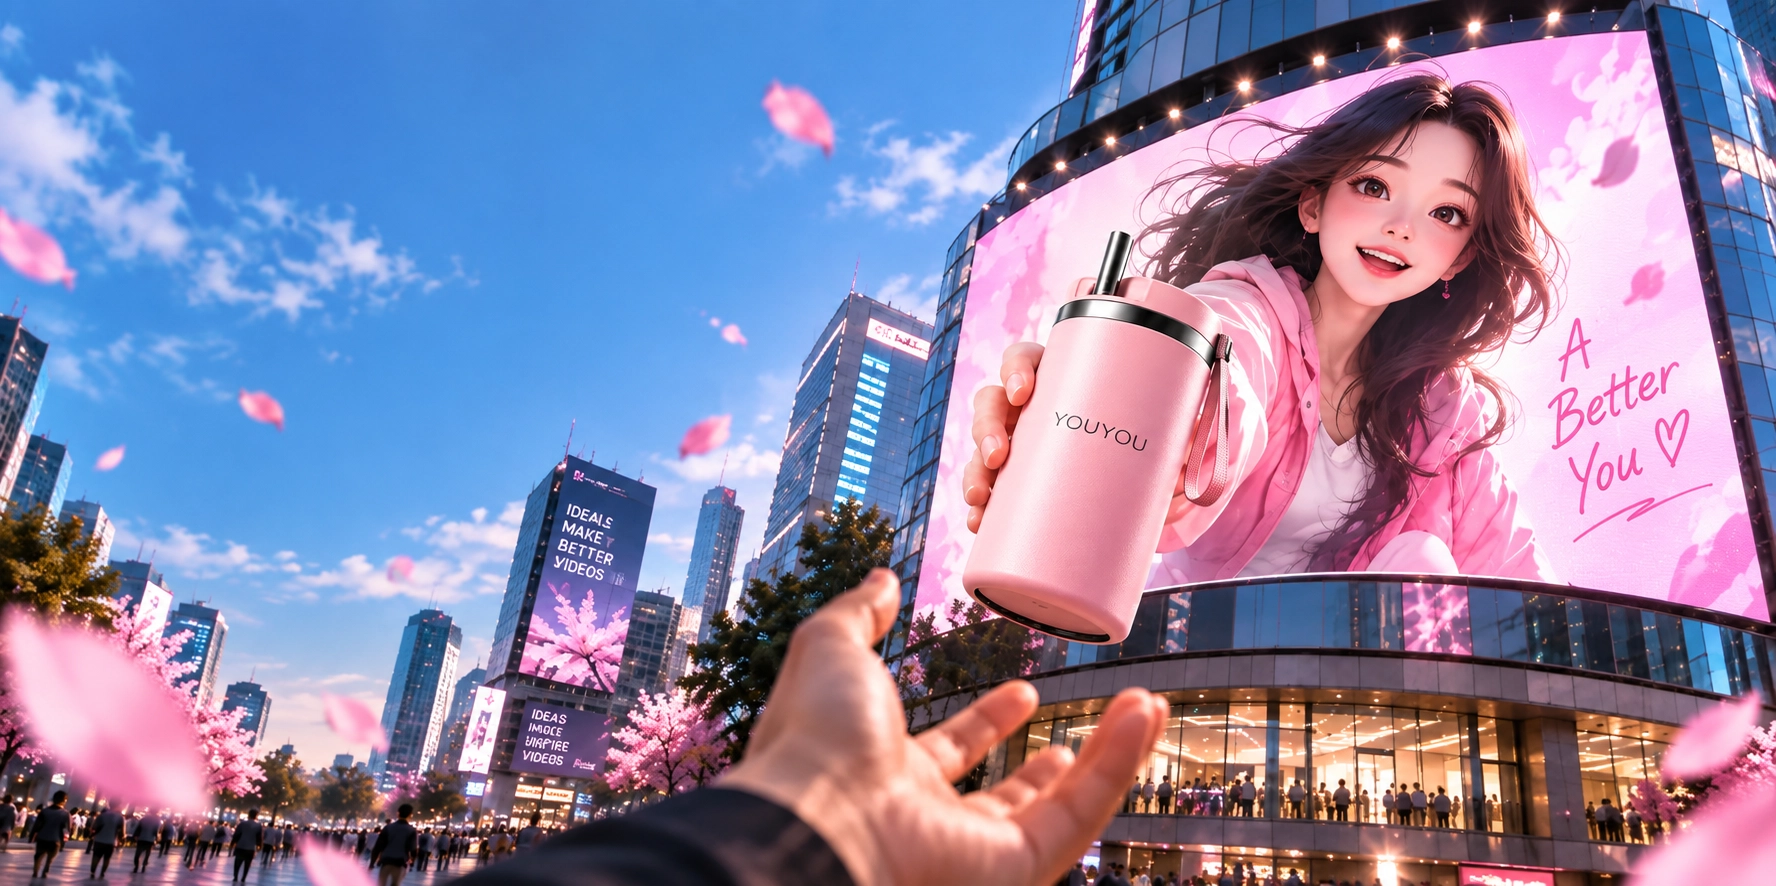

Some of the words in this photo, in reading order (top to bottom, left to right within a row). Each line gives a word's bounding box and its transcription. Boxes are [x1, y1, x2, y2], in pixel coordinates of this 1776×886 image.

[1558, 317, 1592, 382] A
[1547, 361, 1680, 450] Better
[1055, 411, 1147, 452] YOUYOU
[1568, 441, 1643, 515] You
[557, 538, 614, 566] BETTER
[561, 520, 604, 544] MAKE
[531, 708, 567, 725] IDEAS
